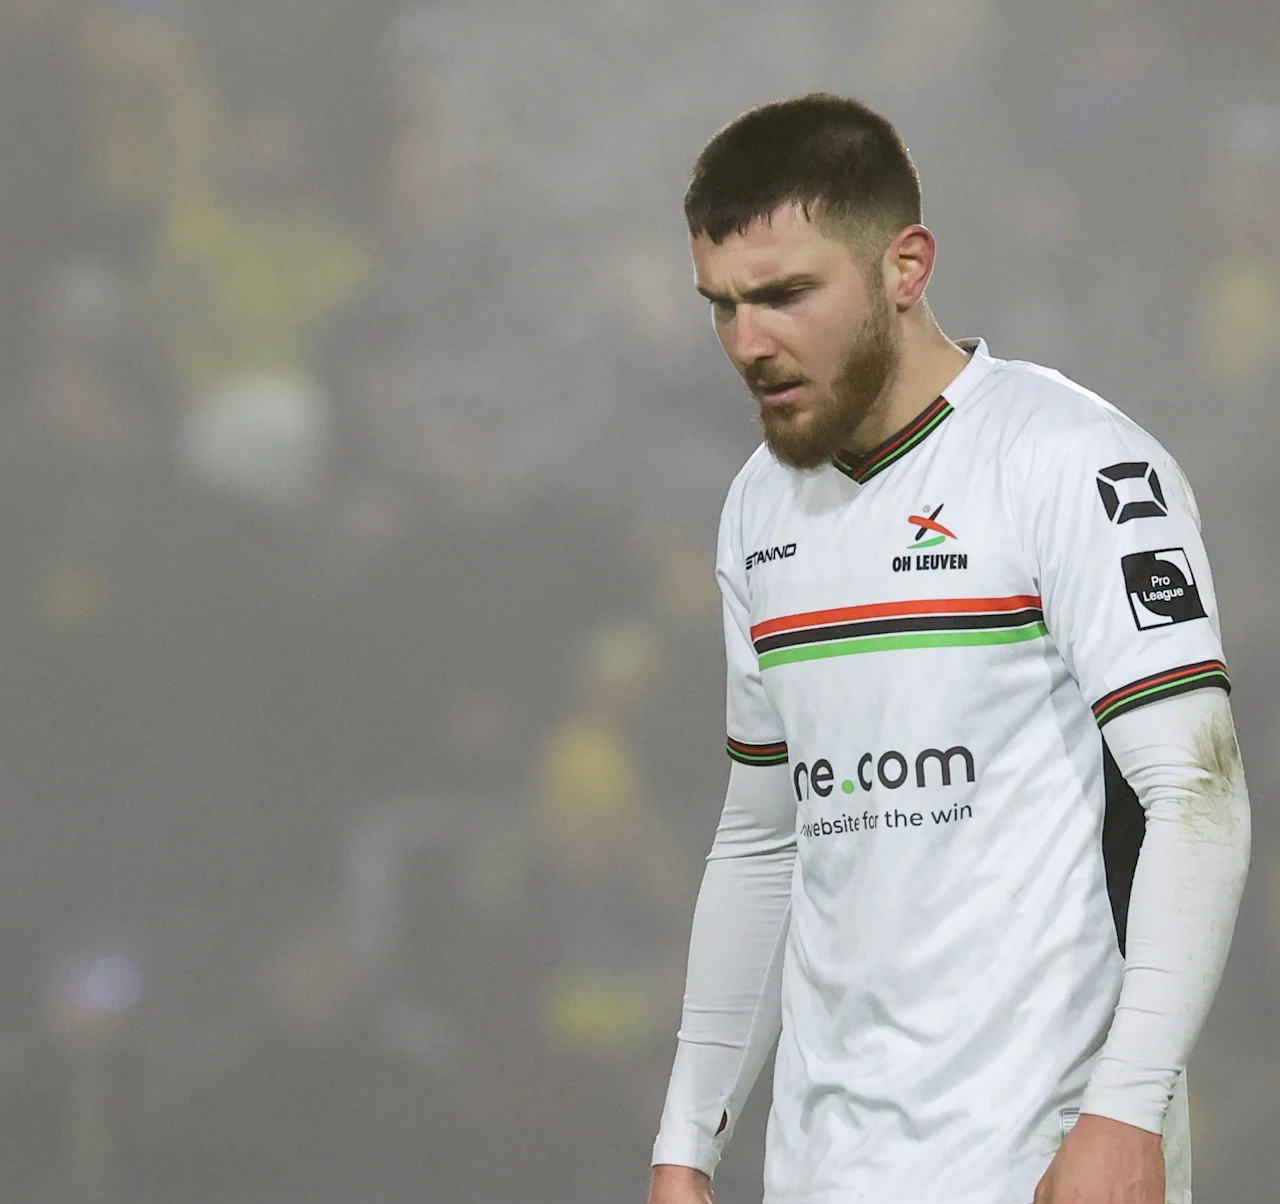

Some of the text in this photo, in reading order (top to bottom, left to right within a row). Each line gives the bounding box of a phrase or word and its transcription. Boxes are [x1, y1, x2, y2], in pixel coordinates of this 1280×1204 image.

[892, 554, 969, 572] OH LEUVEN
[1150, 575, 1171, 588] Pro
[1142, 587, 1185, 603] League
[861, 810, 879, 831] for
[884, 808, 924, 828] the
[931, 803, 973, 825] win
